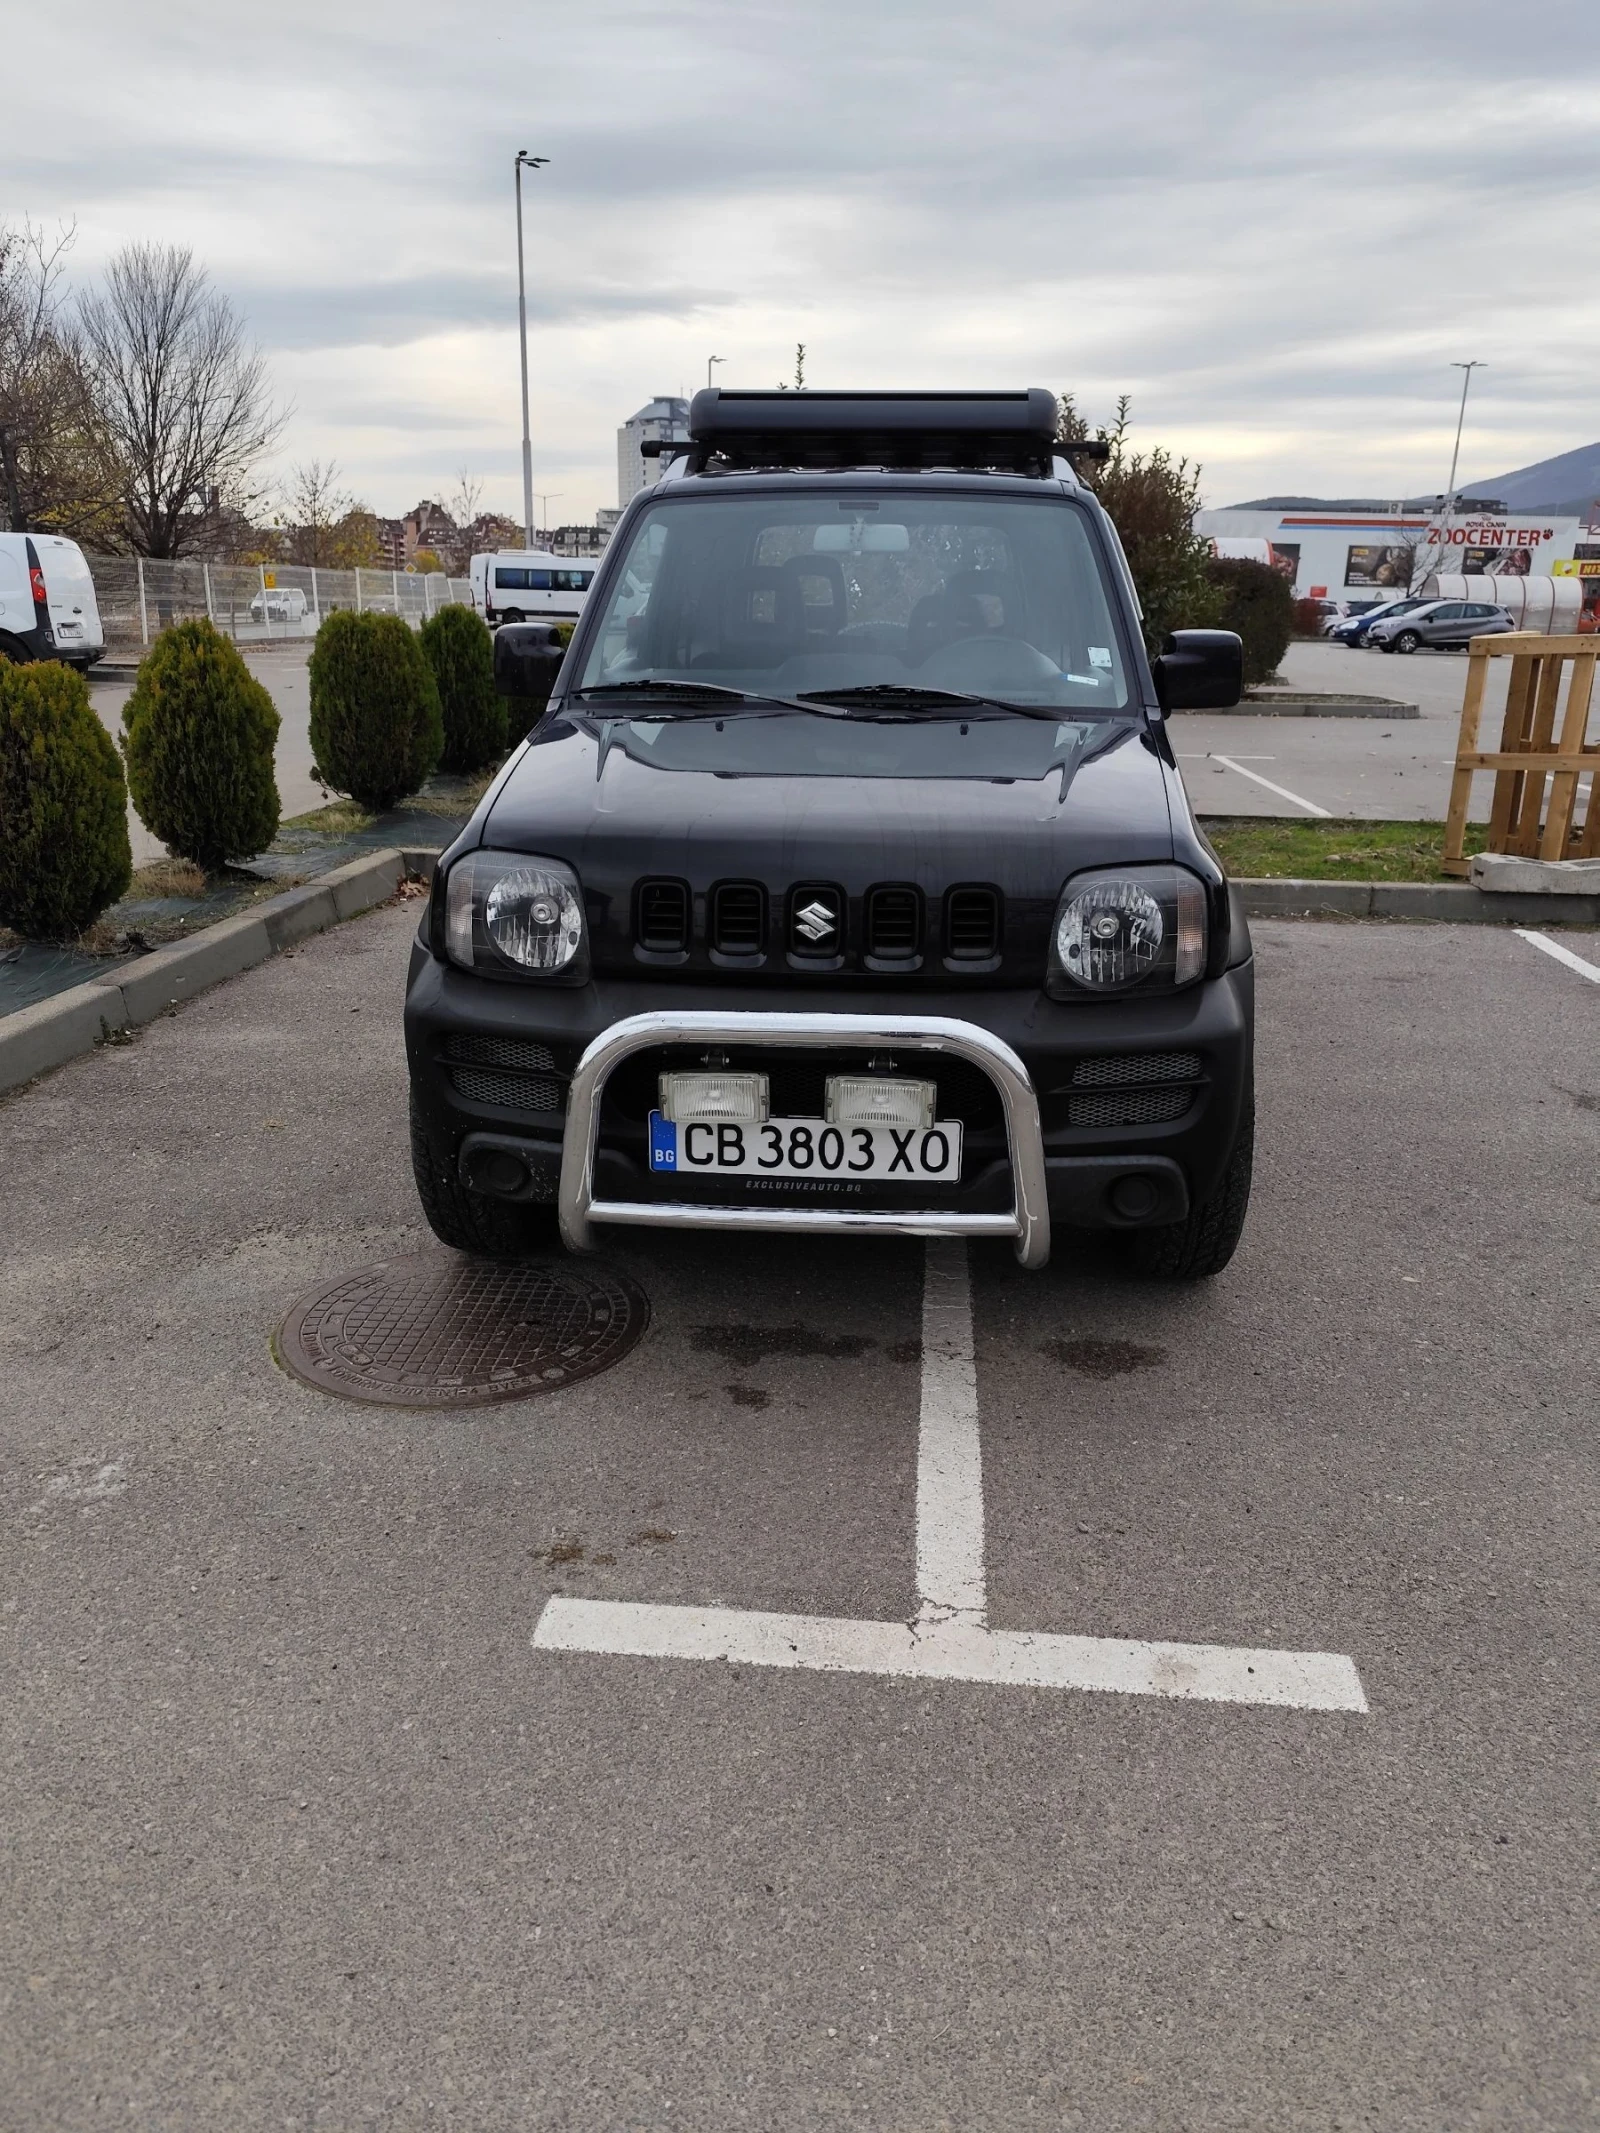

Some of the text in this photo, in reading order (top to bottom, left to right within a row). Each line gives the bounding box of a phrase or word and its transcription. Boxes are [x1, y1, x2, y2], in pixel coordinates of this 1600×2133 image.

[1428, 528, 1541, 546] ZOOCENTER
[684, 1122, 746, 1166] CB
[757, 1125, 875, 1171] 3803
[655, 1149, 675, 1163] BG
[745, 1180, 862, 1193] EXCLUSIVEAUTO.BG
